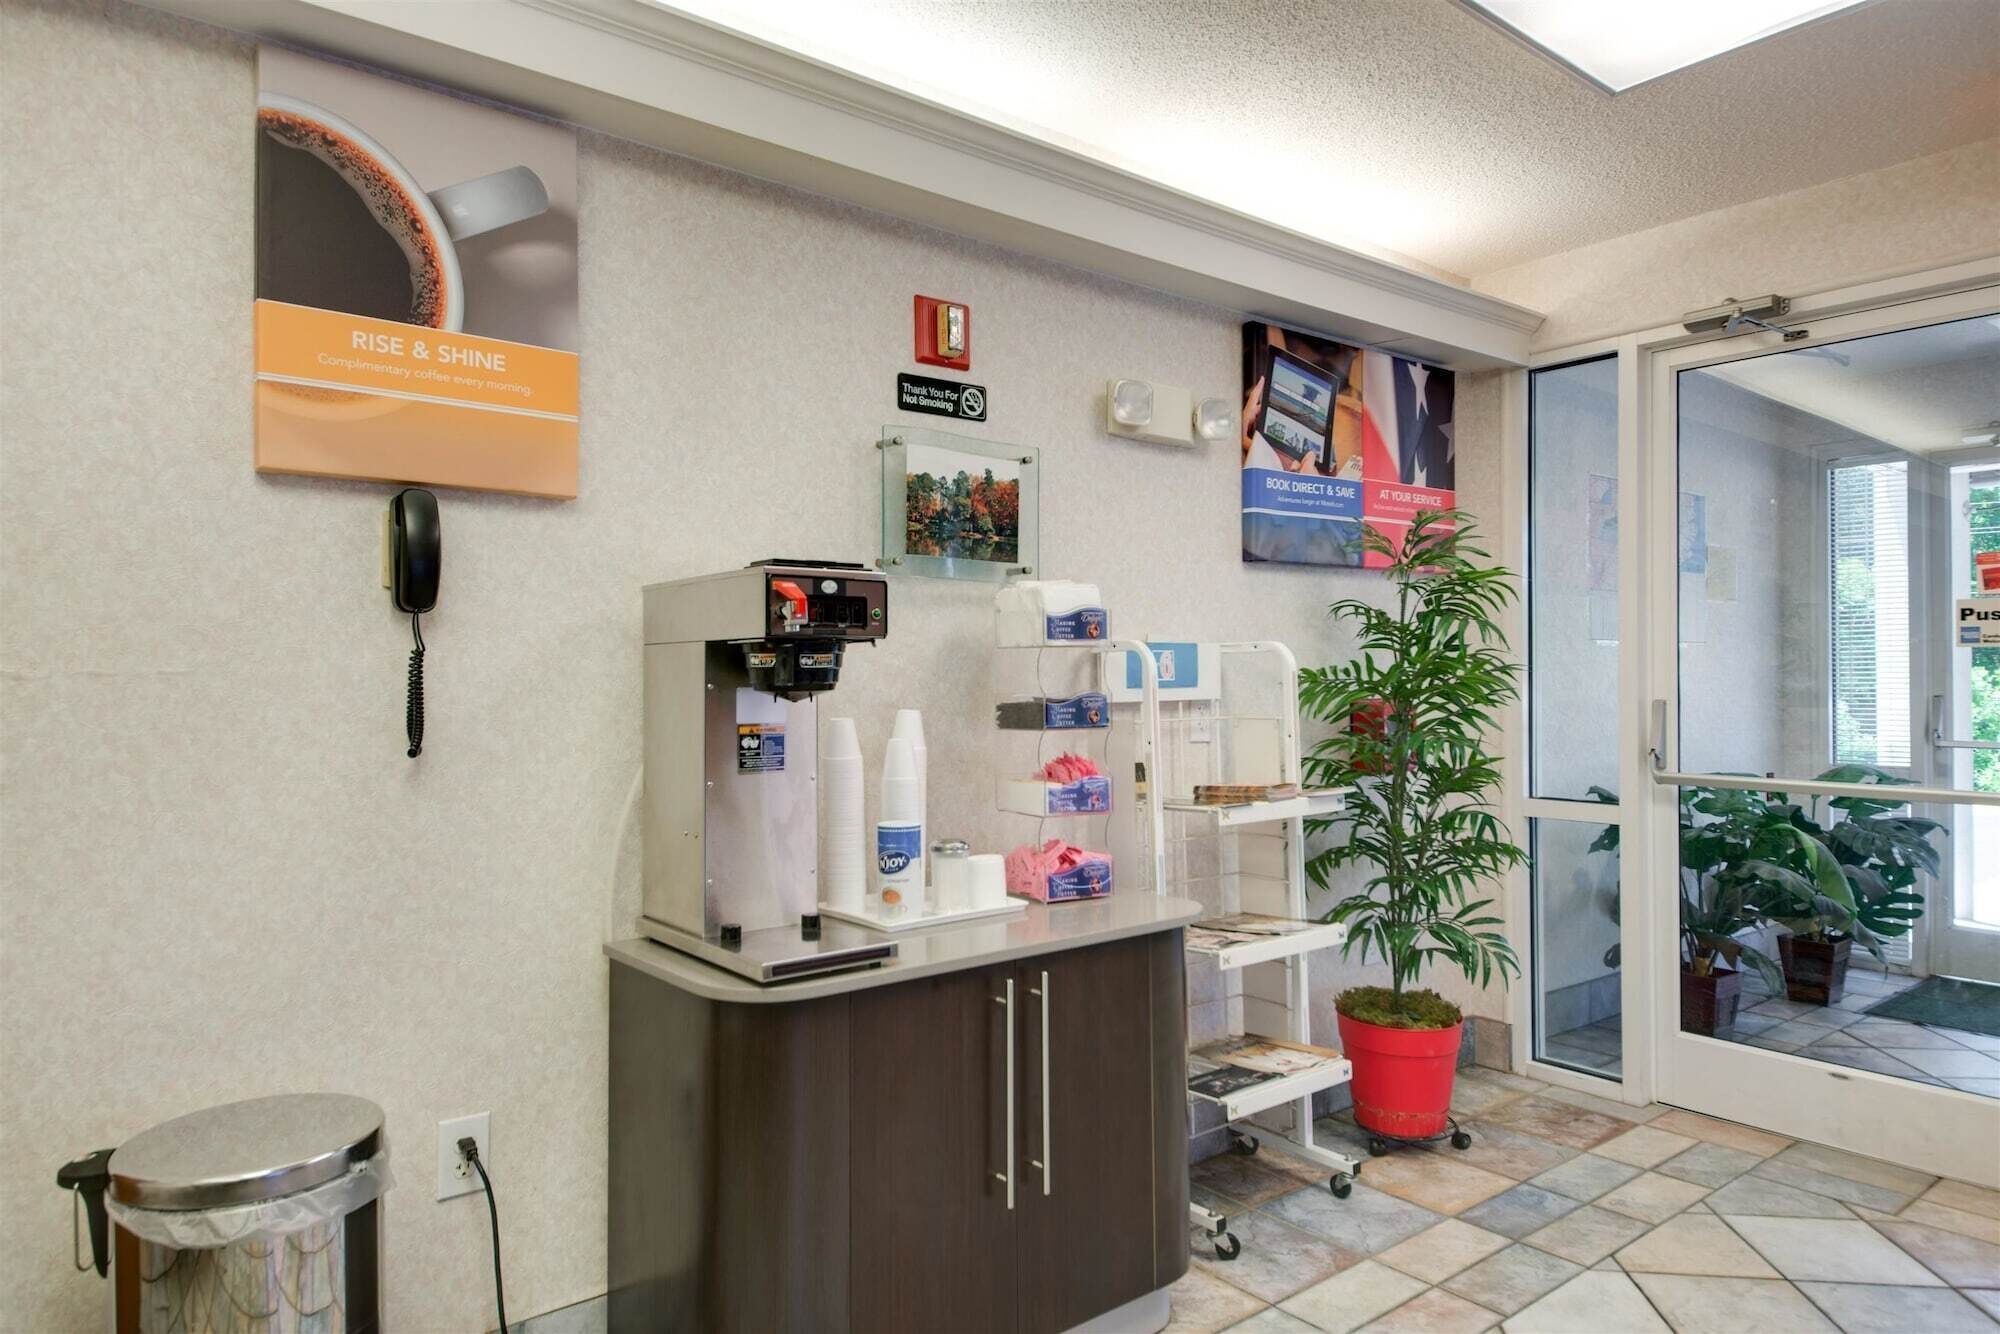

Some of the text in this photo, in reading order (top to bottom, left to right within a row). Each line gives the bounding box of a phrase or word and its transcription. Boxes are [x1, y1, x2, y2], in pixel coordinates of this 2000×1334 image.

[351, 330, 507, 372] RISE & SHINE
[317, 352, 411, 379] Complimentary
[414, 368, 450, 383] coffee
[453, 375, 484, 390] every
[902, 382, 959, 401] Thank You For
[902, 394, 953, 412] Not Smoking
[1265, 477, 1356, 498] BOOK DIRECT & SAVE
[1380, 489, 1443, 507] AT YOUR SERVICE
